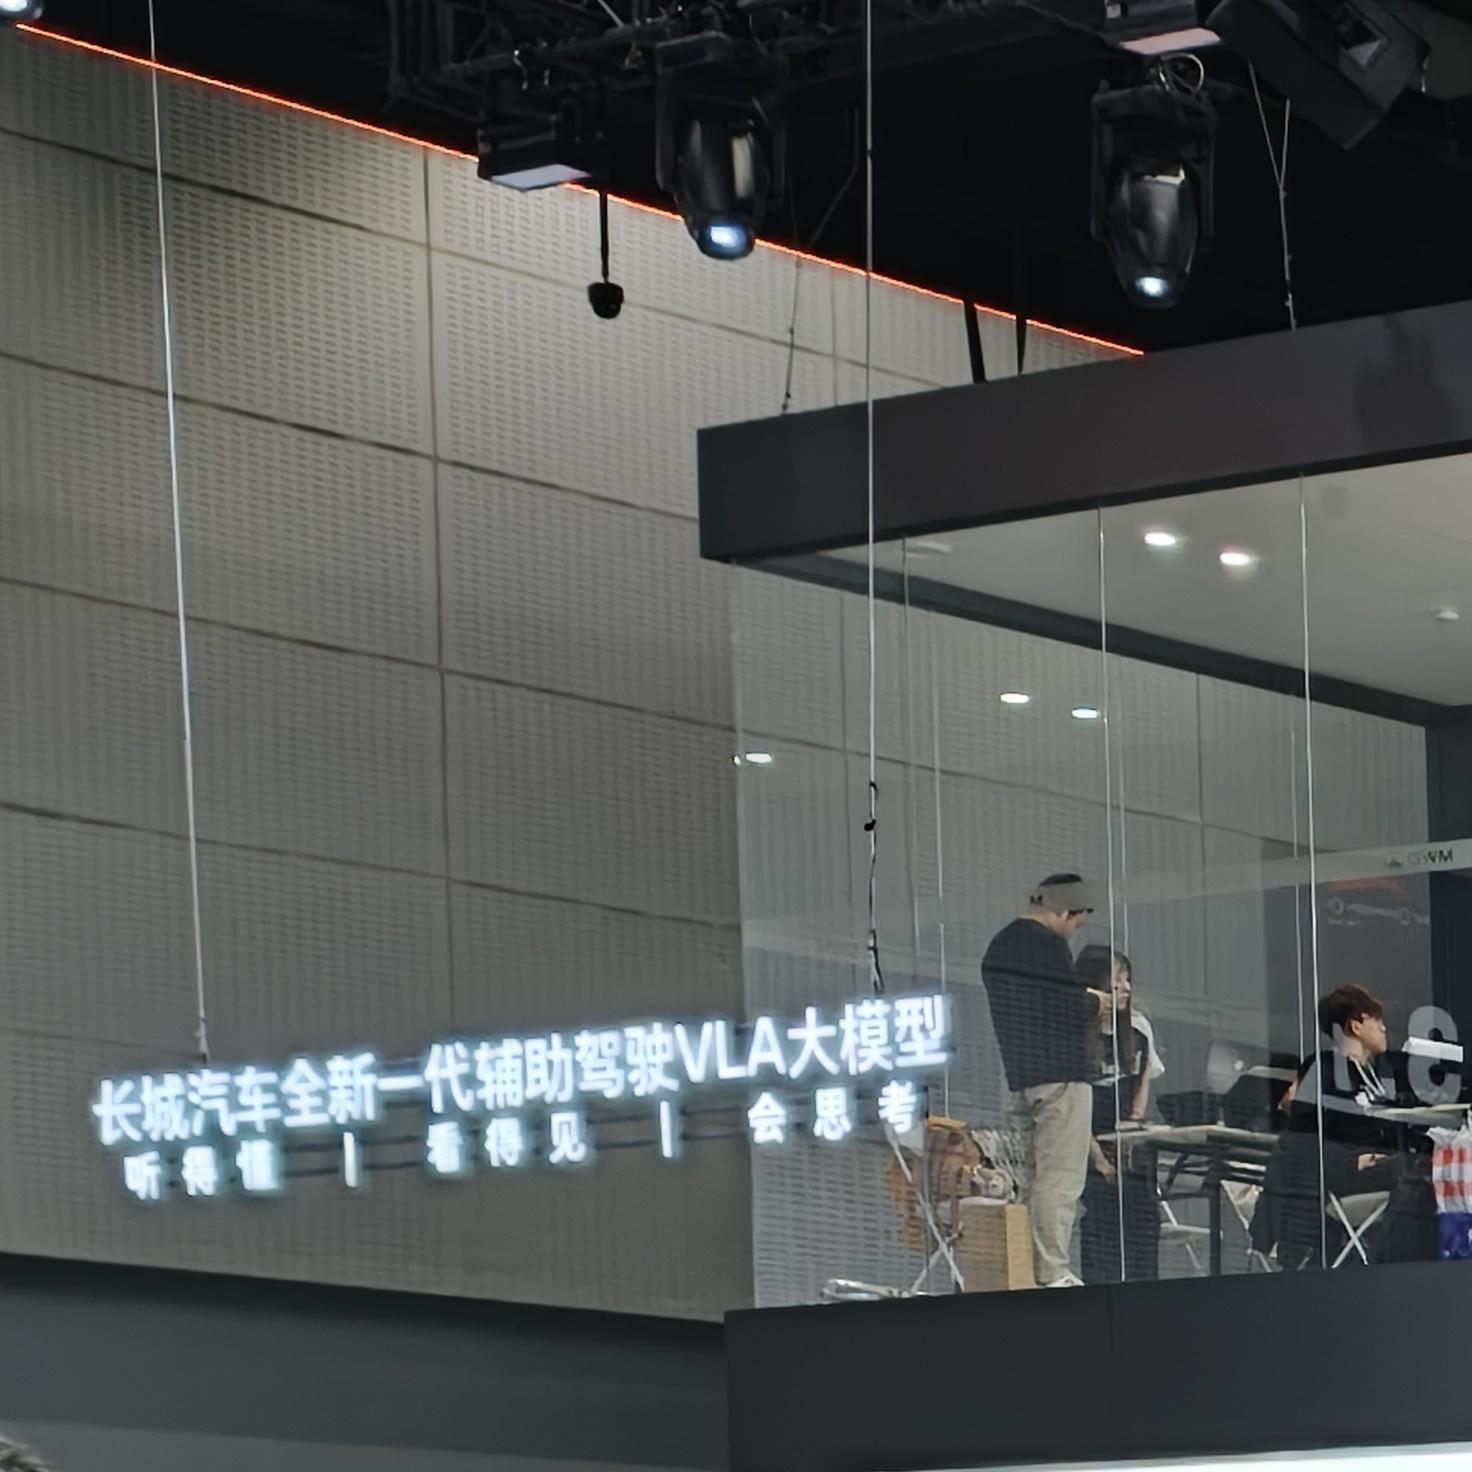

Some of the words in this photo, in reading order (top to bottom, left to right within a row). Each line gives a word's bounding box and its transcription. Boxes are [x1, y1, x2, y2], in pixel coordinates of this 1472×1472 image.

[92, 994, 949, 1146] 长城汽车全新一代辅助驾驶VLA大模型
